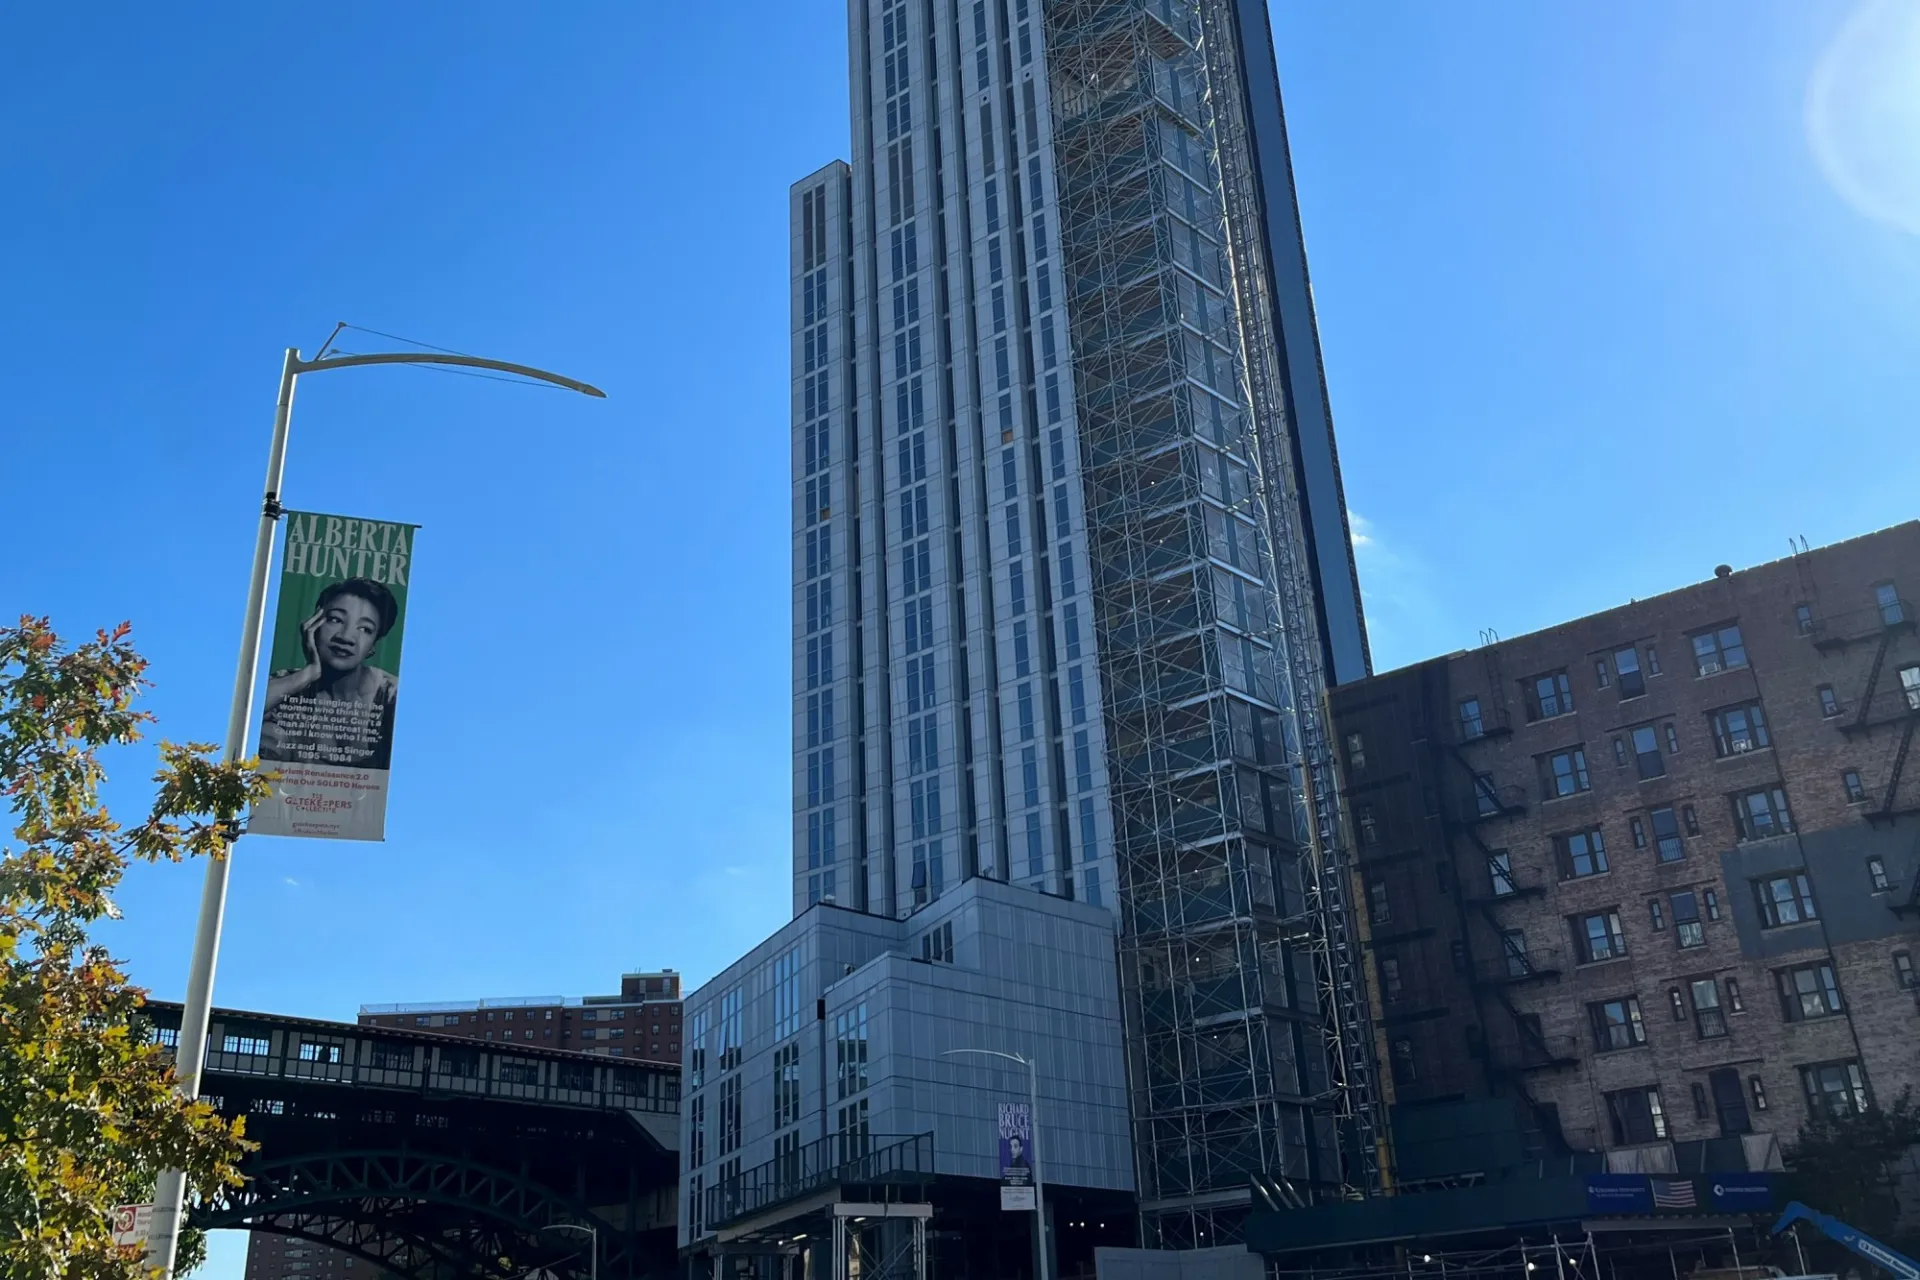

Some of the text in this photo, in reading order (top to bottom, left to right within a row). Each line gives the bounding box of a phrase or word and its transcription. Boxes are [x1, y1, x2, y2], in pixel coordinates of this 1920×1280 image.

[288, 513, 409, 555] ALBERTA
[284, 541, 408, 587] HUNTER
[299, 695, 317, 704] just
[318, 698, 352, 710] singing
[280, 704, 383, 720] women who think they
[301, 714, 329, 723] speak
[277, 720, 298, 728] man
[299, 721, 321, 730] alive
[323, 723, 361, 734] mistreat
[309, 729, 334, 739] know
[335, 732, 355, 741] who
[276, 740, 375, 757] Jazz and Blues Singer
[298, 750, 320, 760] 1895
[329, 752, 352, 762] 1984
[356, 773, 369, 781] 2.0
[998, 1103, 1029, 1114] RICHARD
[998, 1114, 1029, 1128] BRUCE
